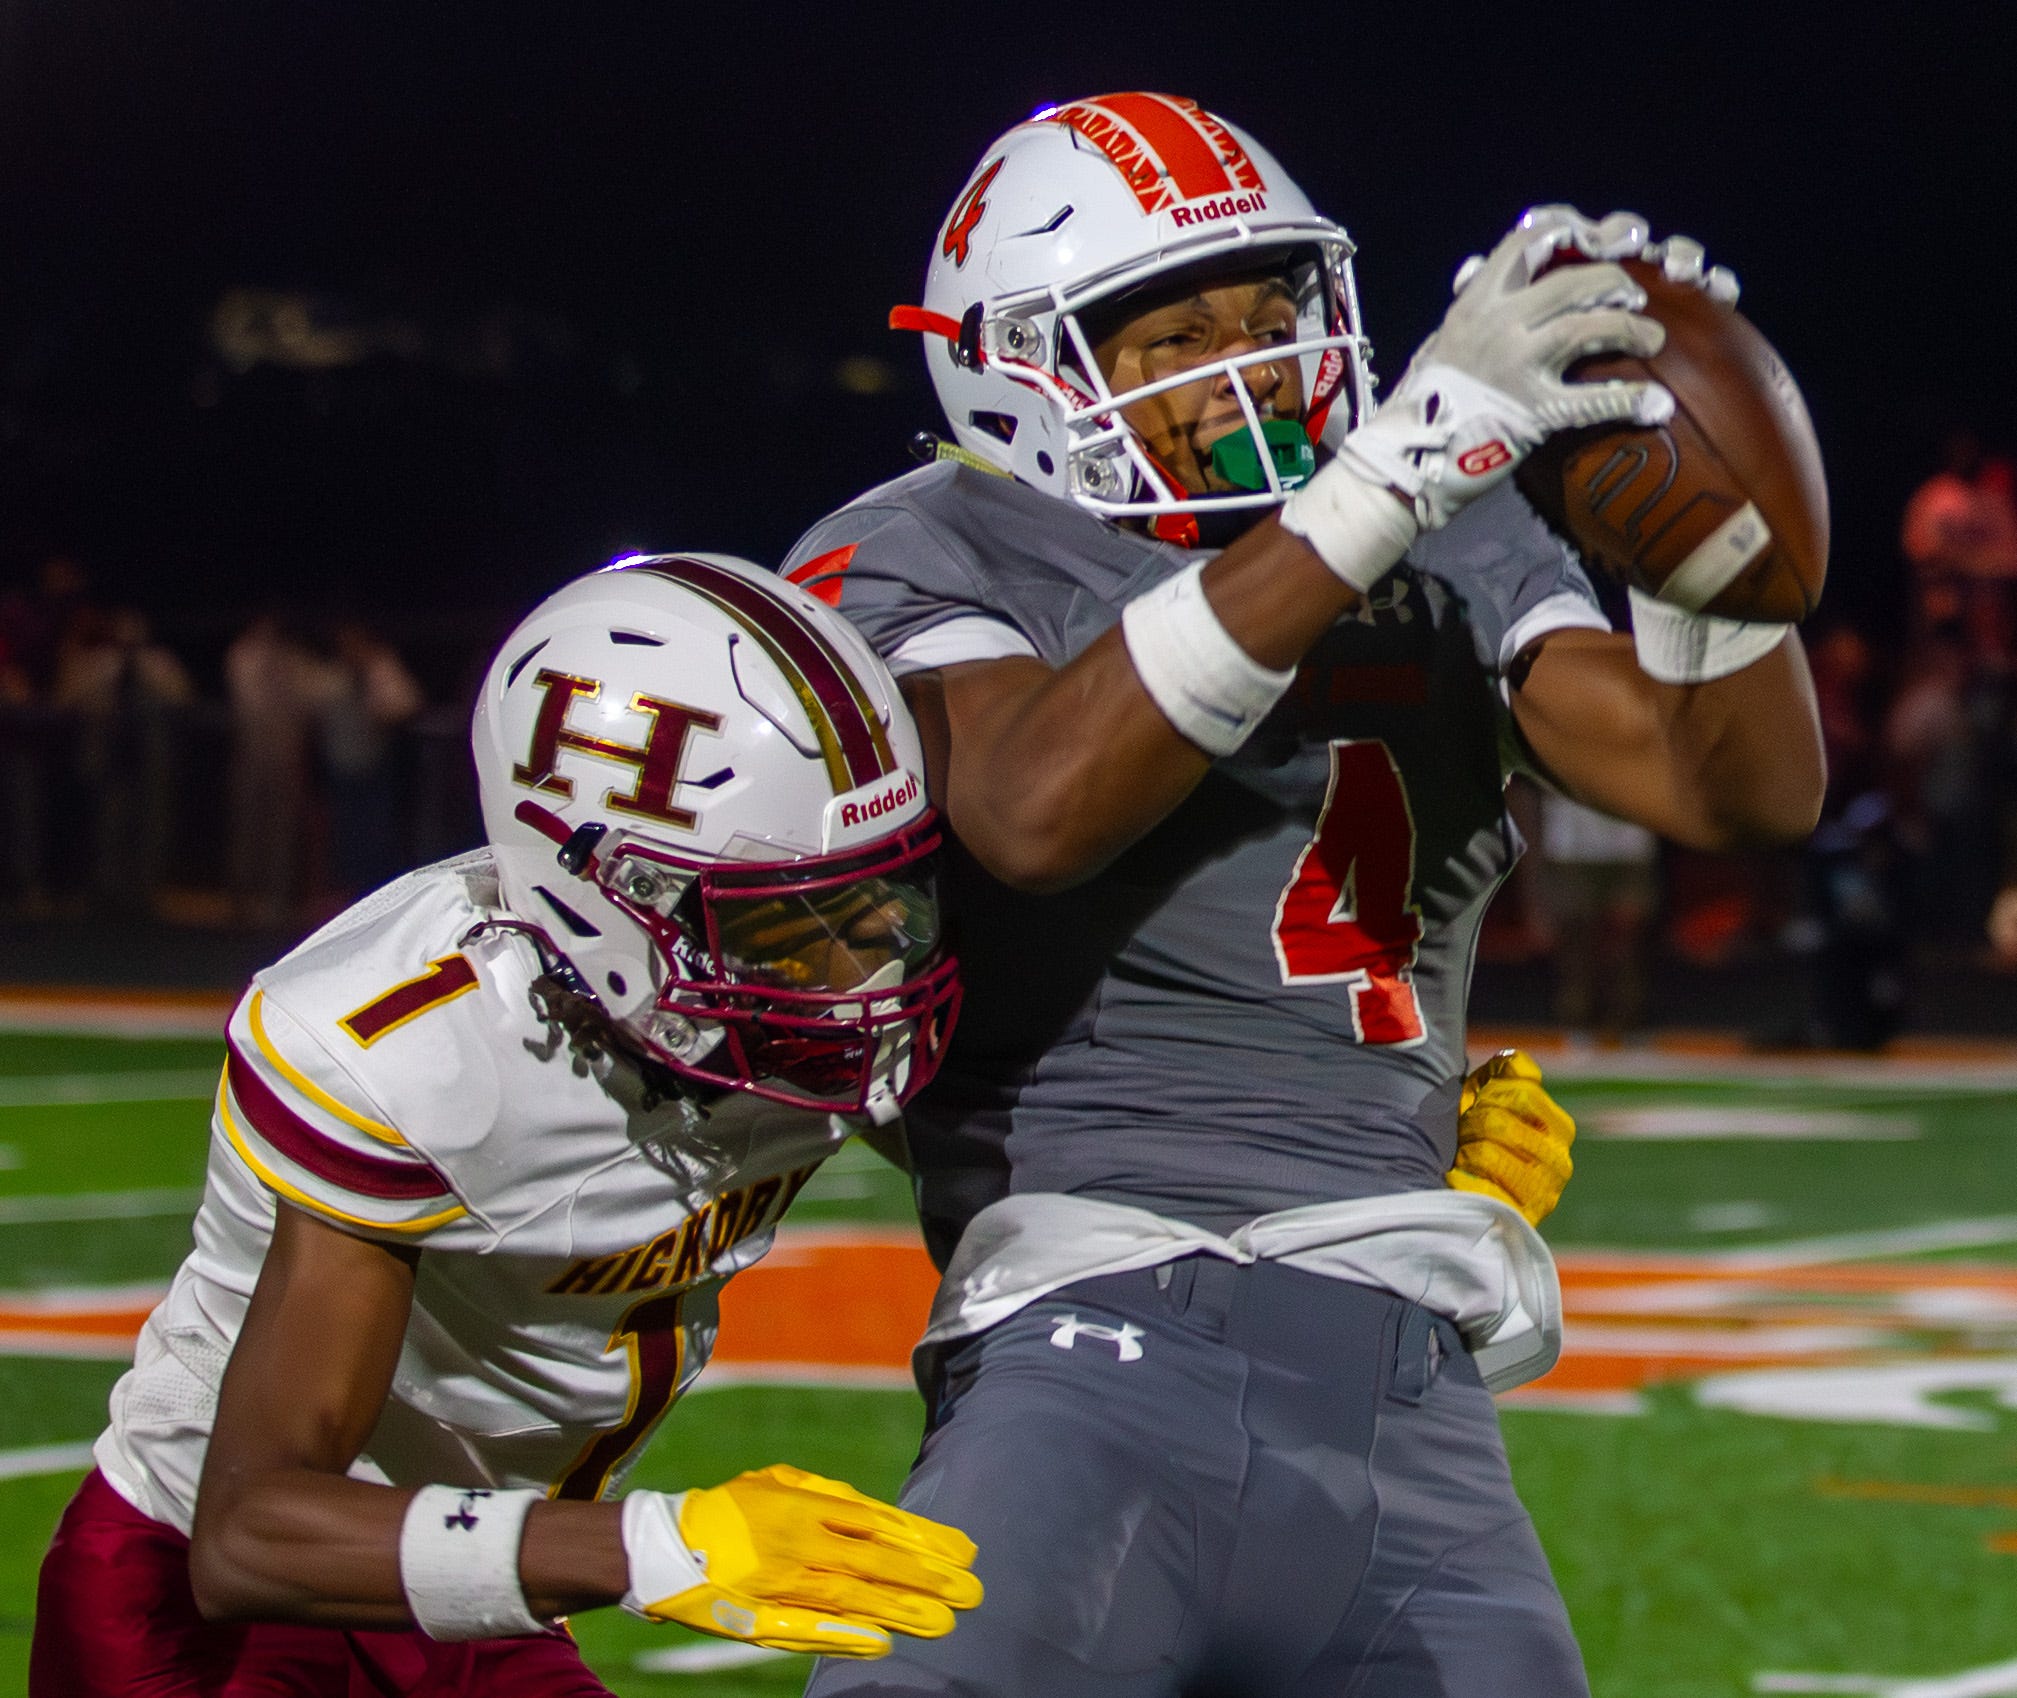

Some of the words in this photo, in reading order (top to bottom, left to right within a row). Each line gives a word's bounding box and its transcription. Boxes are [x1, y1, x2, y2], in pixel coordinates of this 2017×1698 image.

[941, 154, 1008, 268] 4
[1170, 192, 1267, 228] Riddell
[512, 667, 726, 832] H
[840, 774, 918, 829] Riddell
[1271, 738, 1429, 1046] 4
[335, 952, 481, 1051] 1
[546, 1292, 685, 1501] 1
